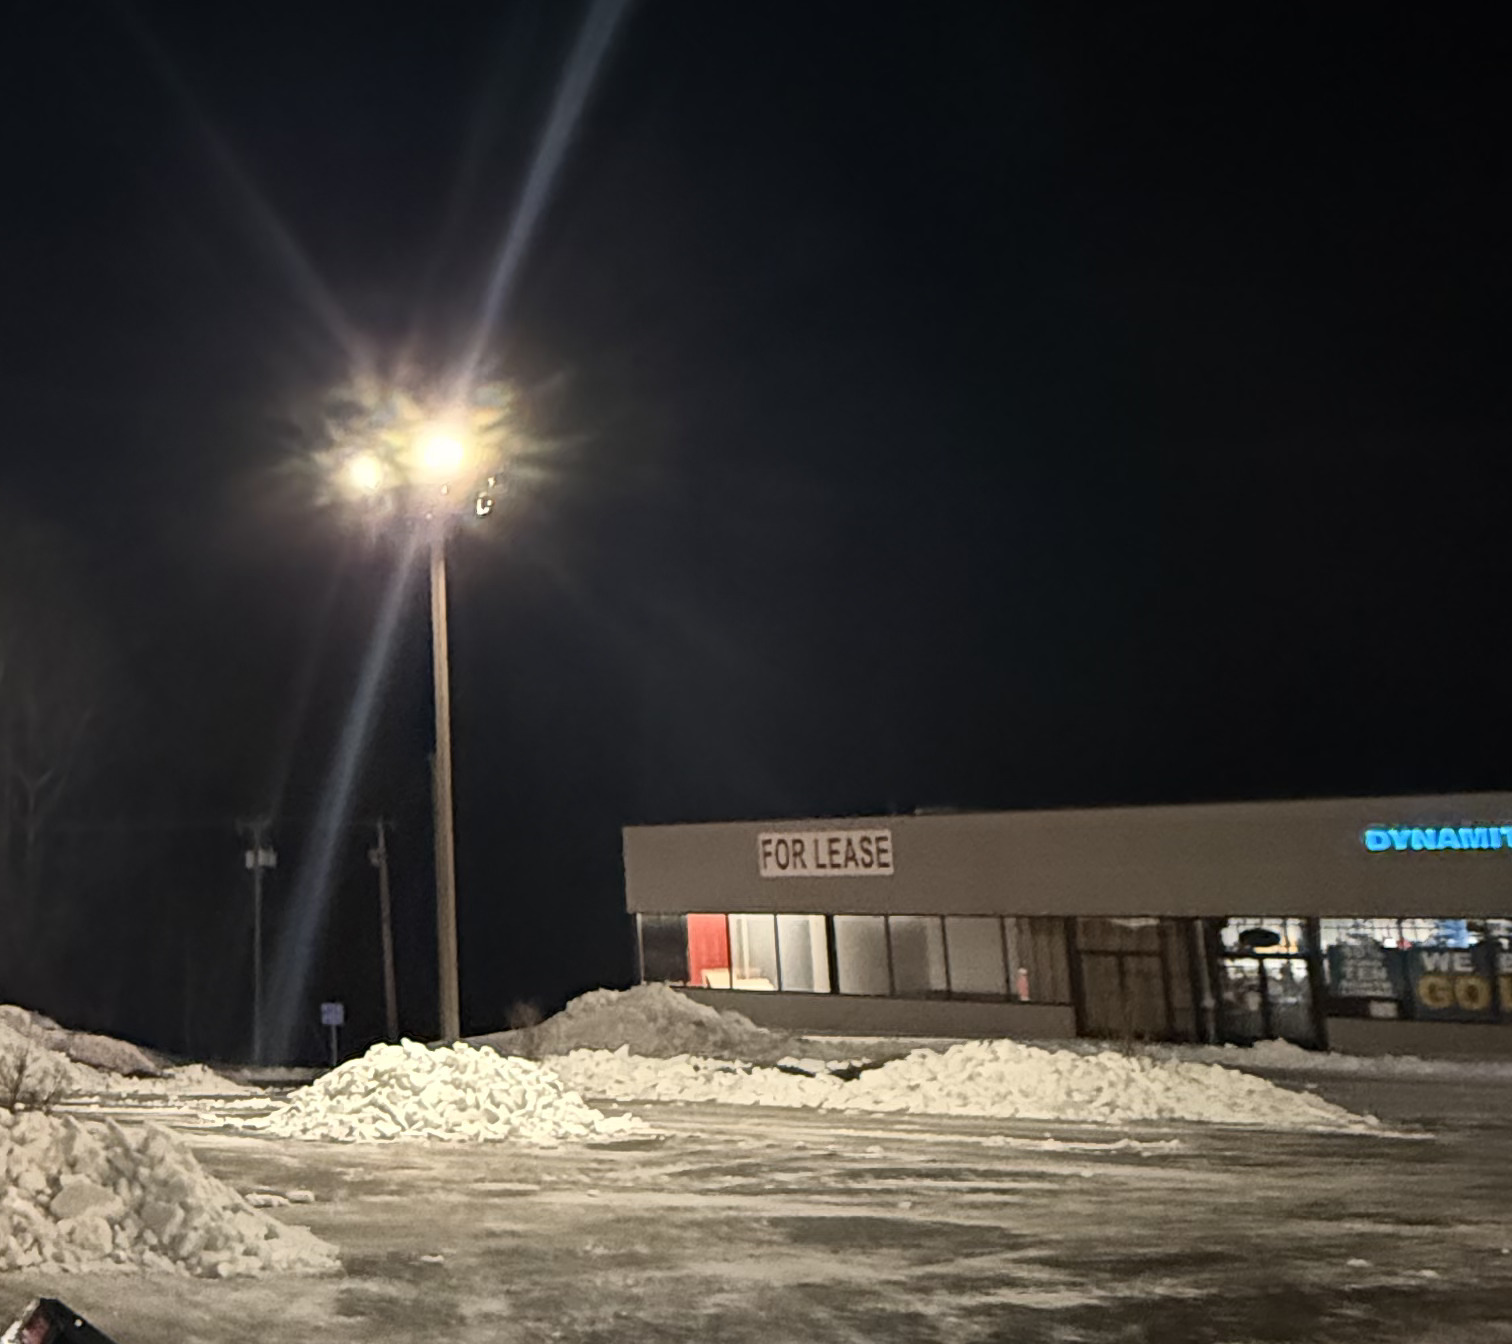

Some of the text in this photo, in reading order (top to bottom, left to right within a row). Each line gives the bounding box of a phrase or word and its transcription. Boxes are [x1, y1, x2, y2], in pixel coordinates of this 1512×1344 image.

[761, 836, 890, 870] FOR LEASE
[1420, 952, 1475, 973] WE
